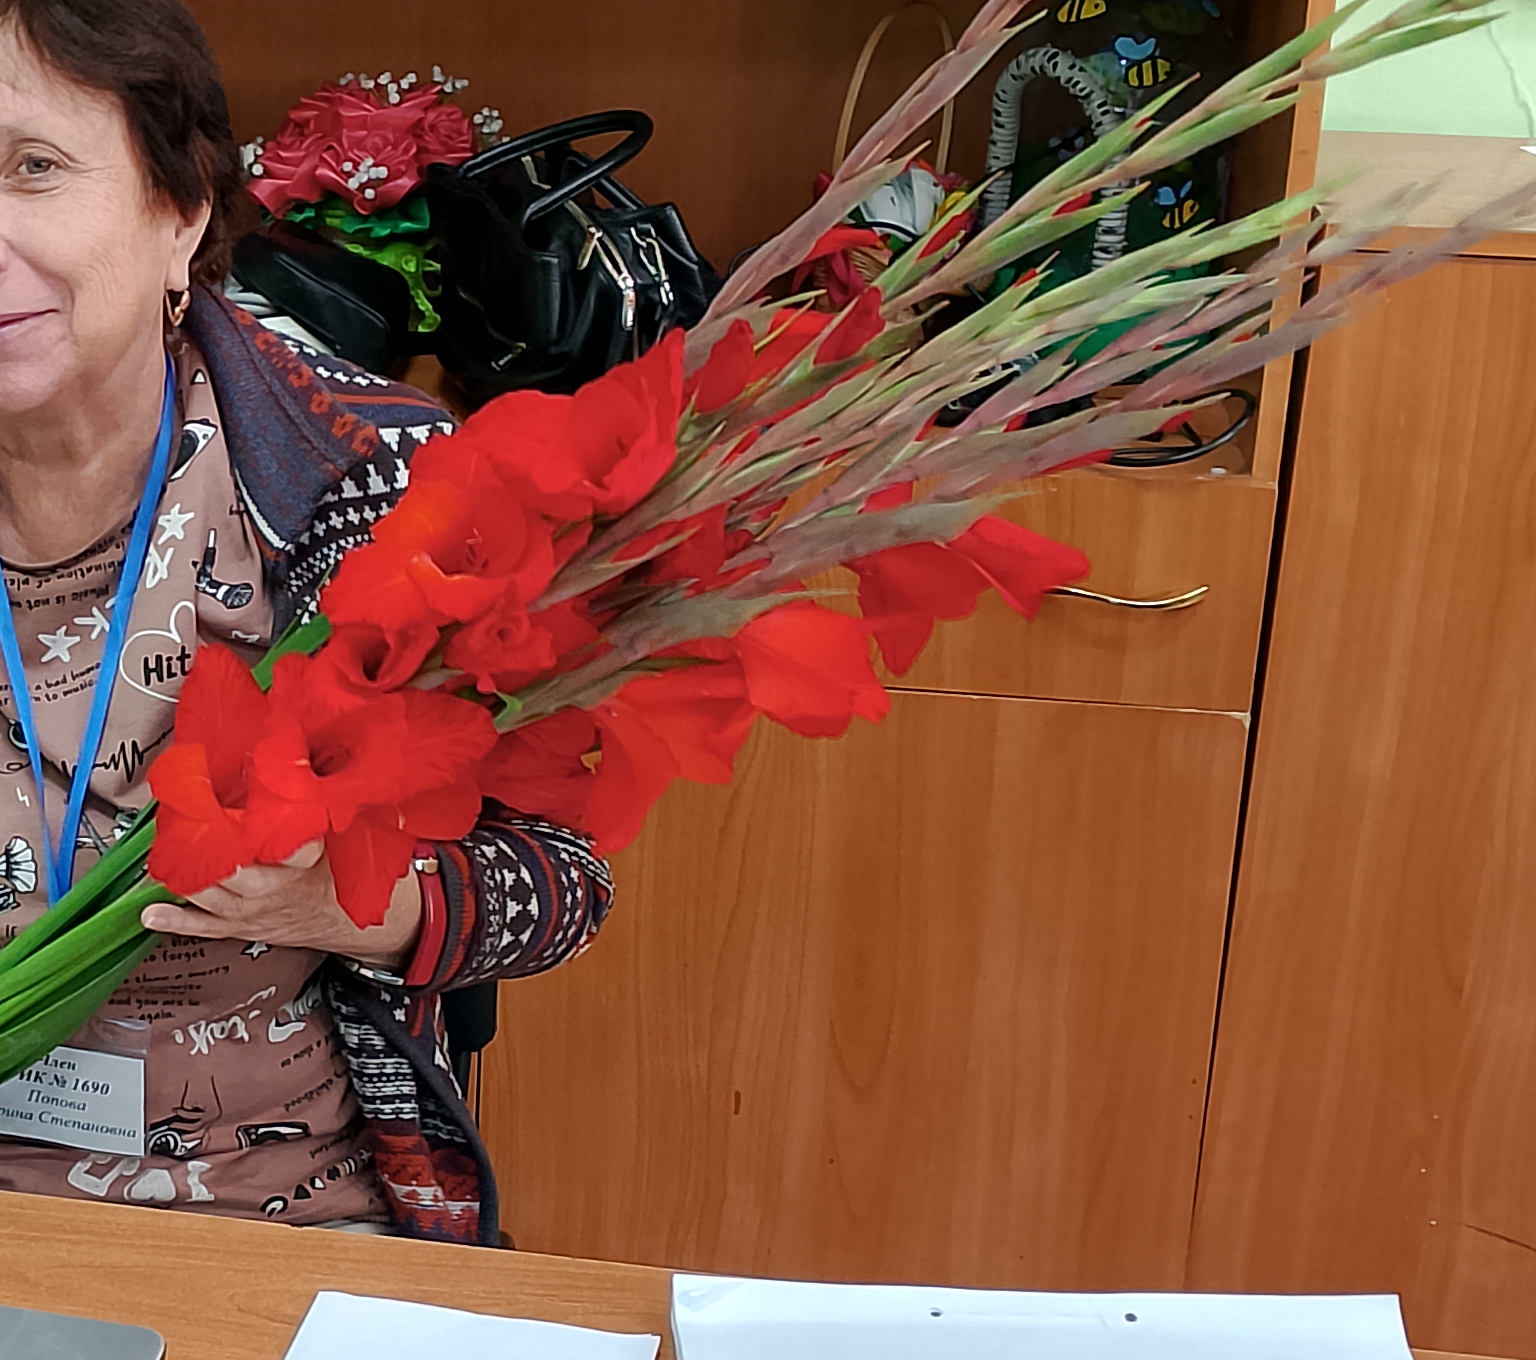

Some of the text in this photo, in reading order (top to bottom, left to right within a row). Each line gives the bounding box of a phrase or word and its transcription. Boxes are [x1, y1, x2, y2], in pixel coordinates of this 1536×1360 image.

[143, 645, 192, 687] Hit
[18, 1068, 47, 1084] ИК
[71, 1078, 111, 1096] 1690
[27, 1088, 88, 1112] Попова
[38, 1110, 138, 1139] Степановна
